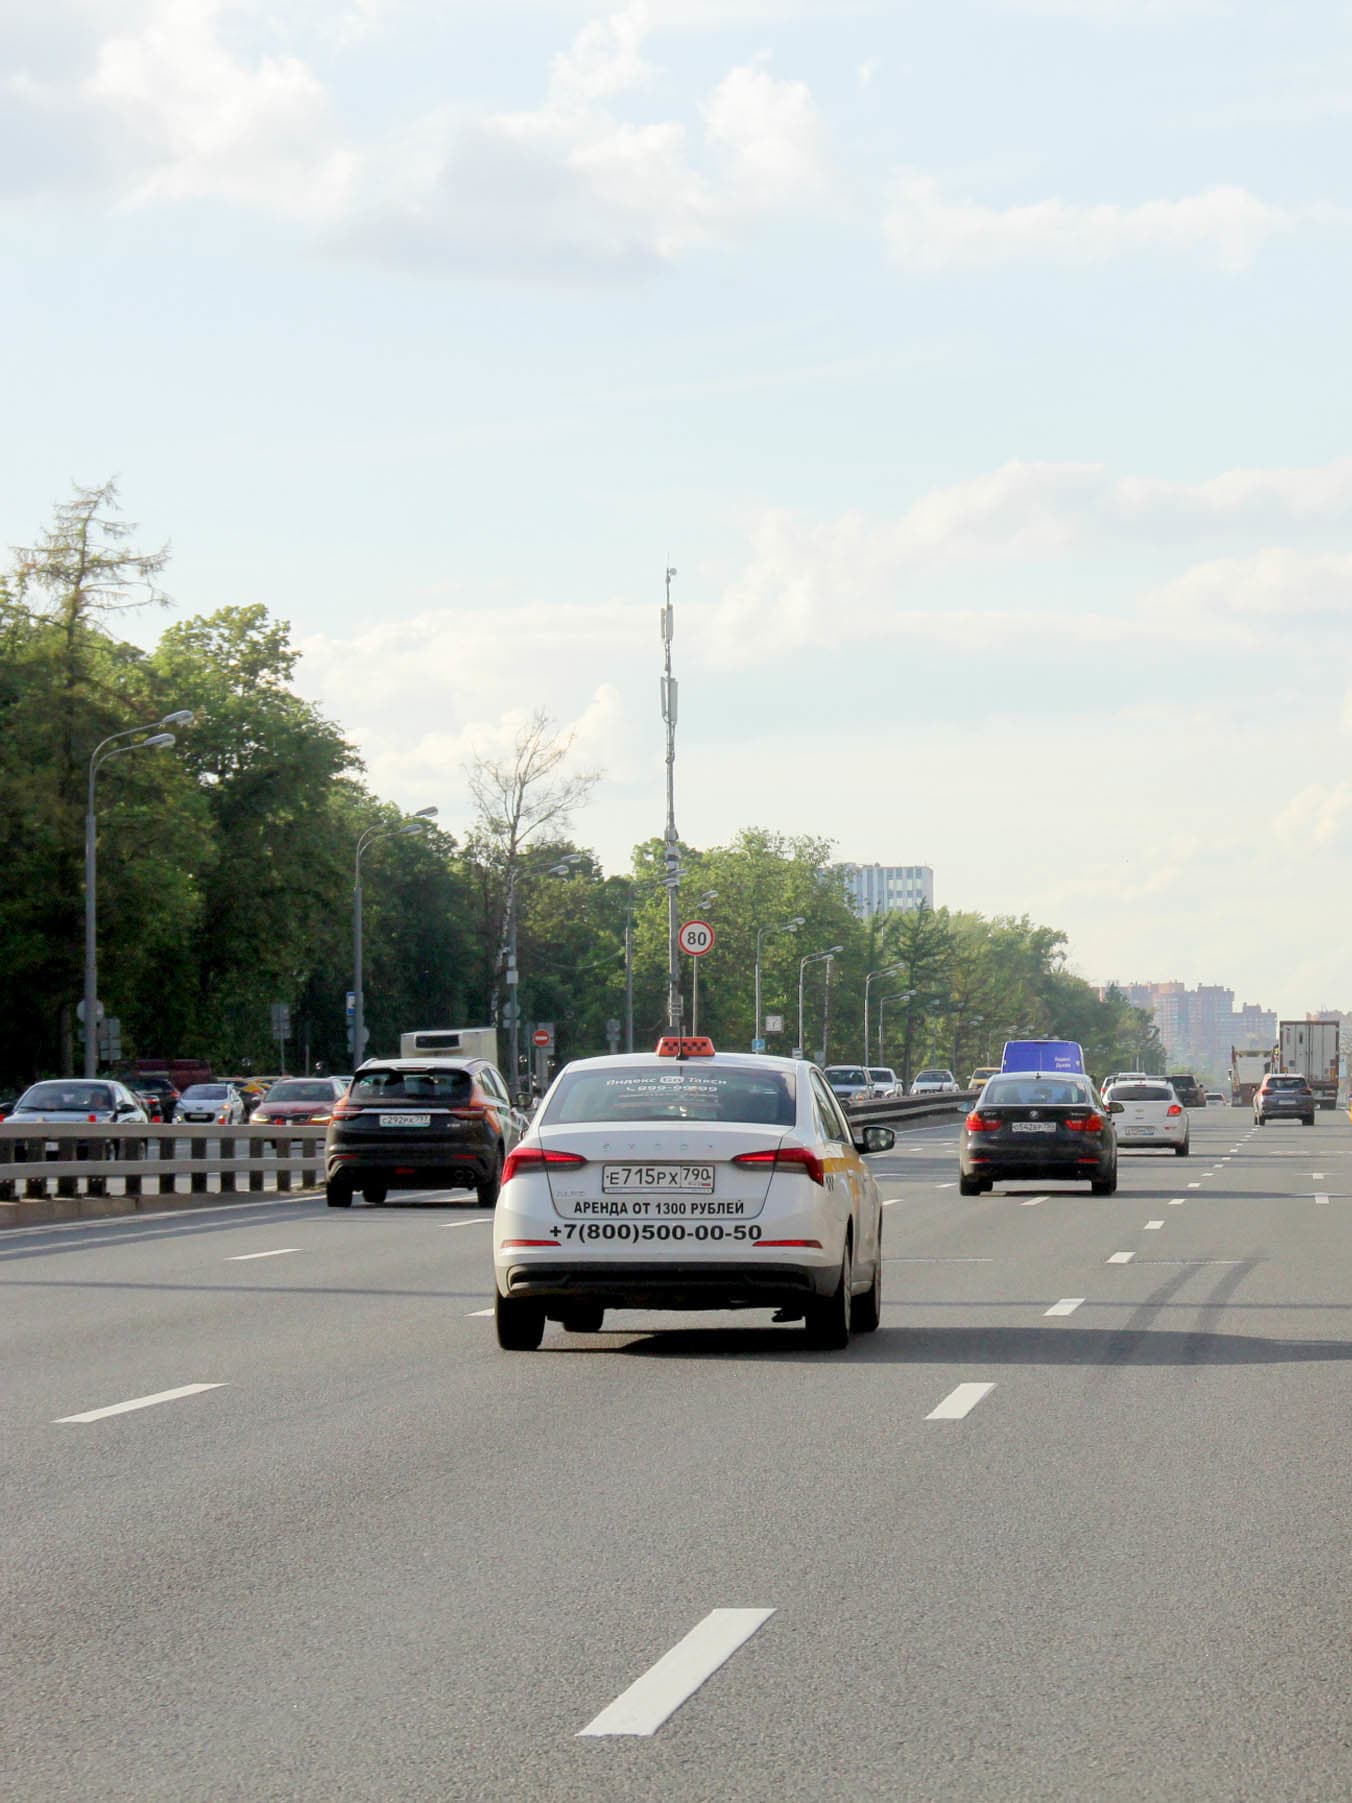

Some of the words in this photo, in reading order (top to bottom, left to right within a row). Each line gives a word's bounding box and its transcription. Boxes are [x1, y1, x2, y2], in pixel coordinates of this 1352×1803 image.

[687, 931, 707, 946] 80
[683, 1168, 710, 1180] 790
[574, 1201, 630, 1216] АРЕНДА
[632, 1202, 651, 1215] ОТ
[655, 1202, 686, 1215] 1300
[691, 1200, 744, 1215] РУБЛЕЙ
[550, 1223, 763, 1244] +7(800)500-00-50
